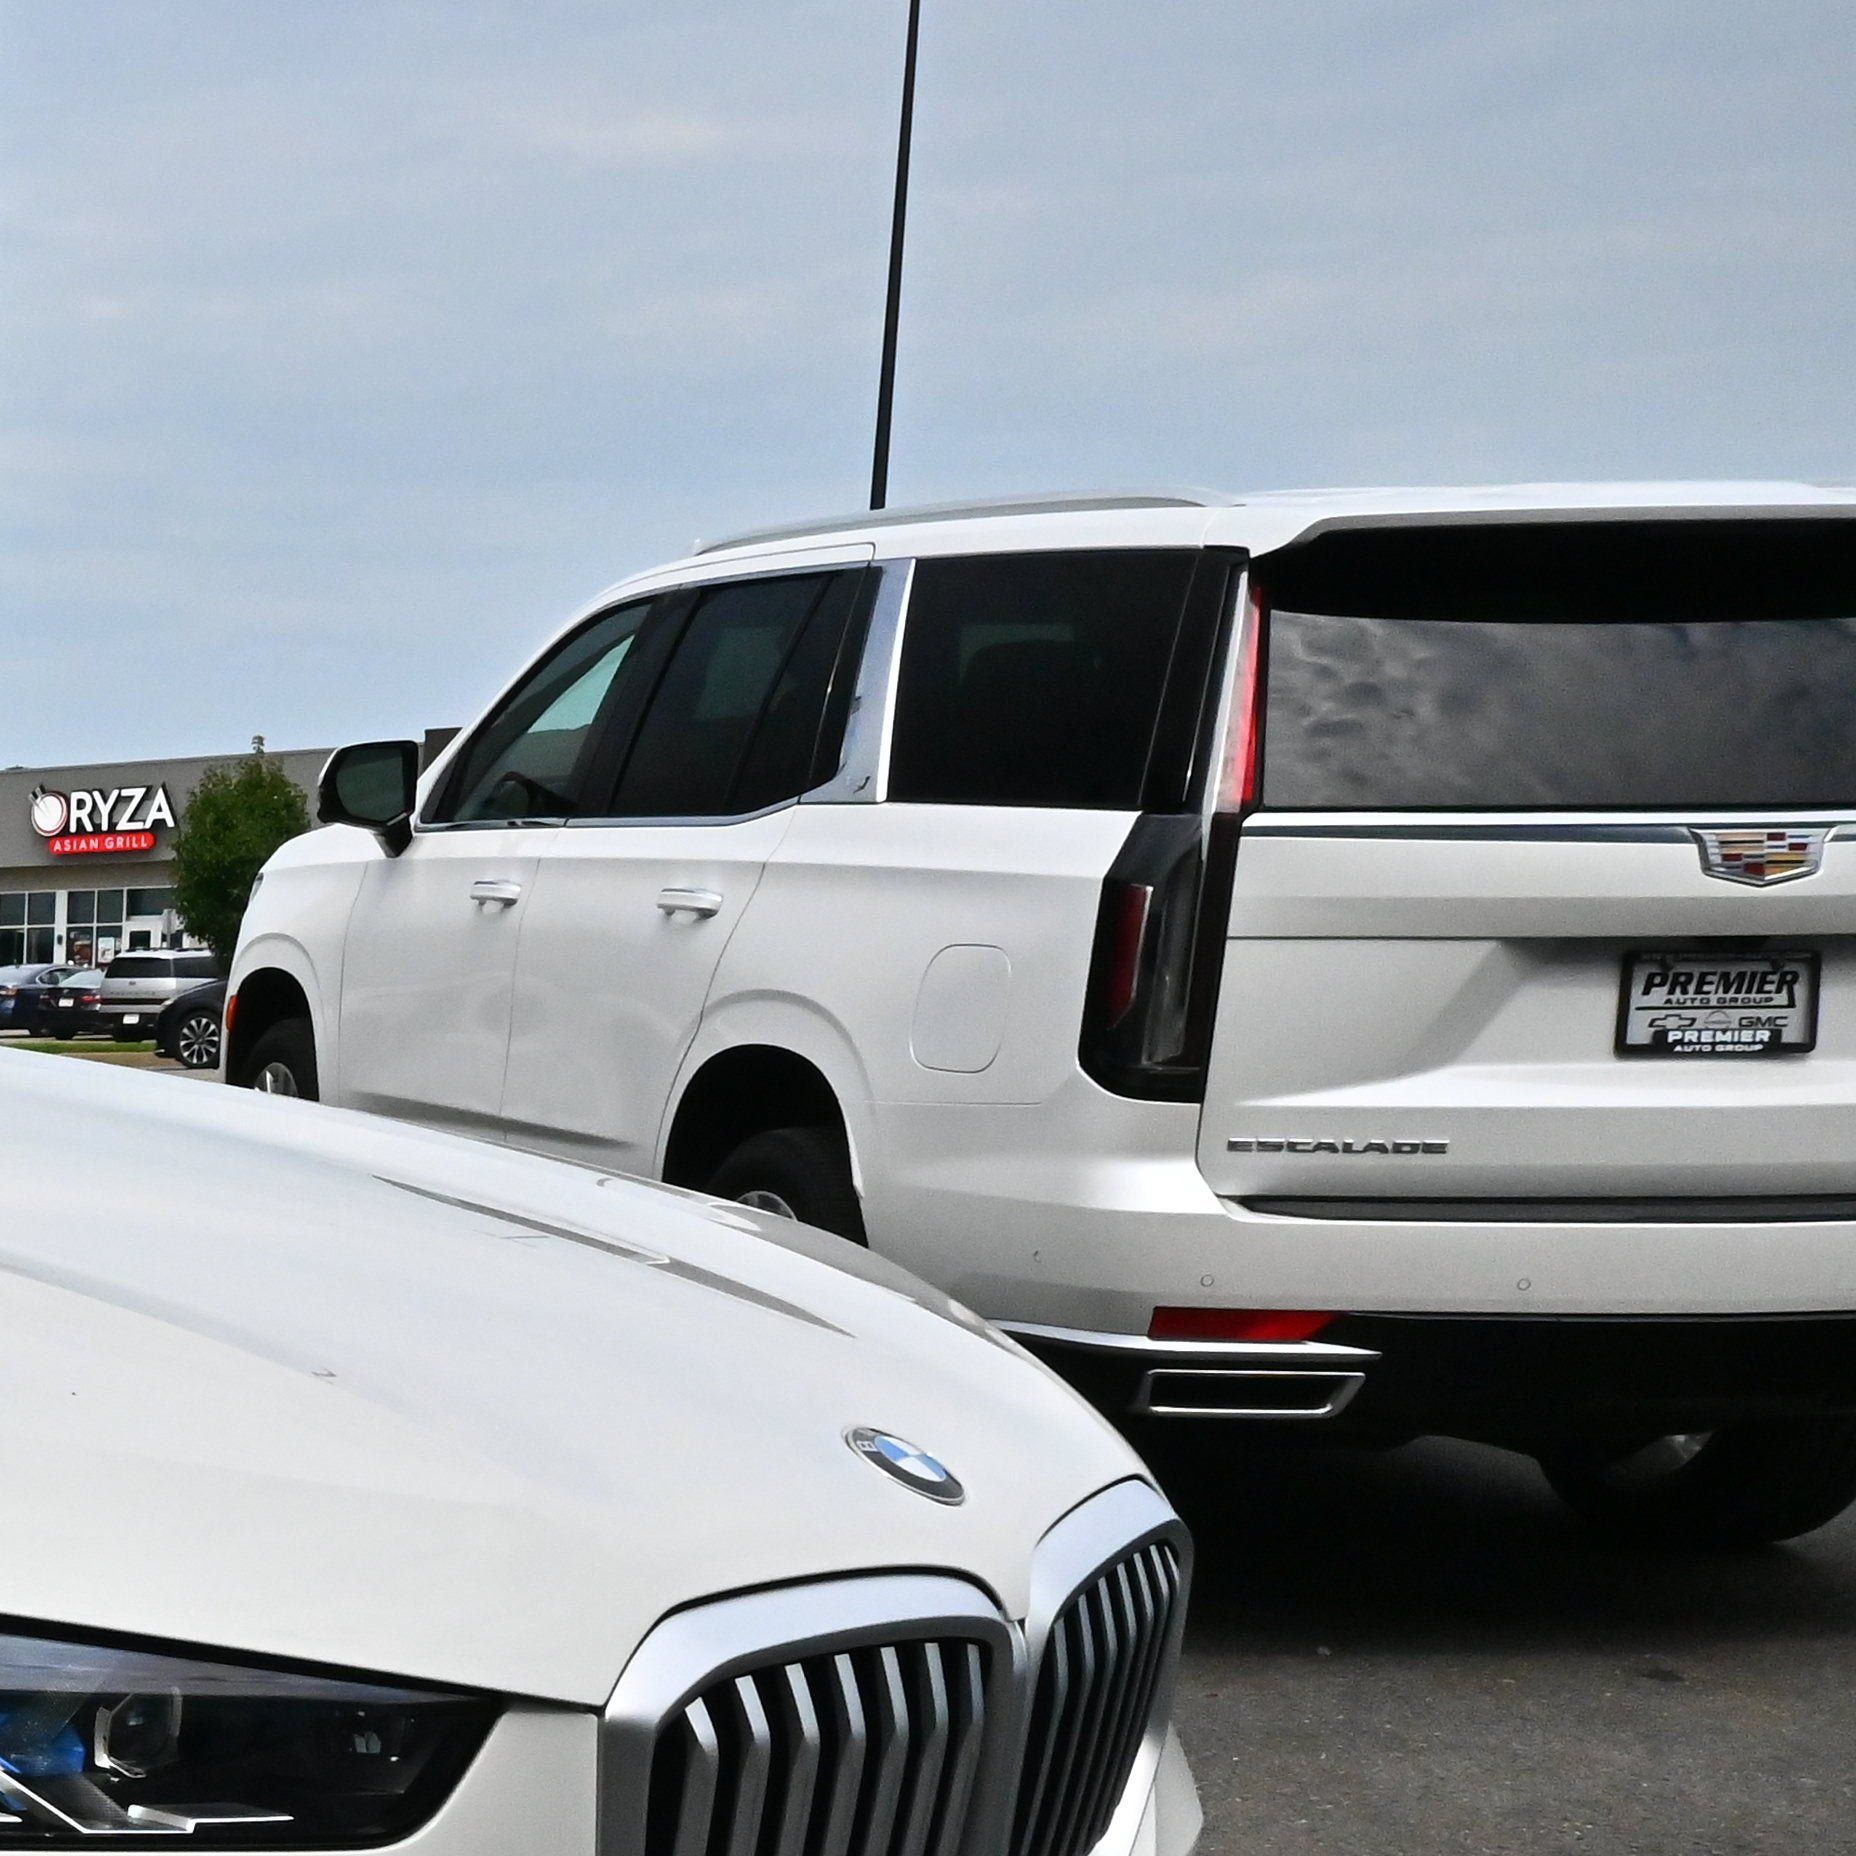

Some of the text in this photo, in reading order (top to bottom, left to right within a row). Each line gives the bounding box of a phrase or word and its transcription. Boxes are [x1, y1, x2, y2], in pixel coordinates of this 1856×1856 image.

[30, 786, 176, 837] ORYZA
[53, 835, 148, 851] ASIAN GRILL
[1642, 970, 1800, 1008] PREMIER
[1663, 996, 1774, 1006] AUTO GROUP
[1738, 1016, 1789, 1028] GMC
[1667, 1030, 1772, 1043] PREMIER
[1673, 1044, 1764, 1052] AUTO GROUP
[1227, 1137, 1450, 1154] ESCALADE
